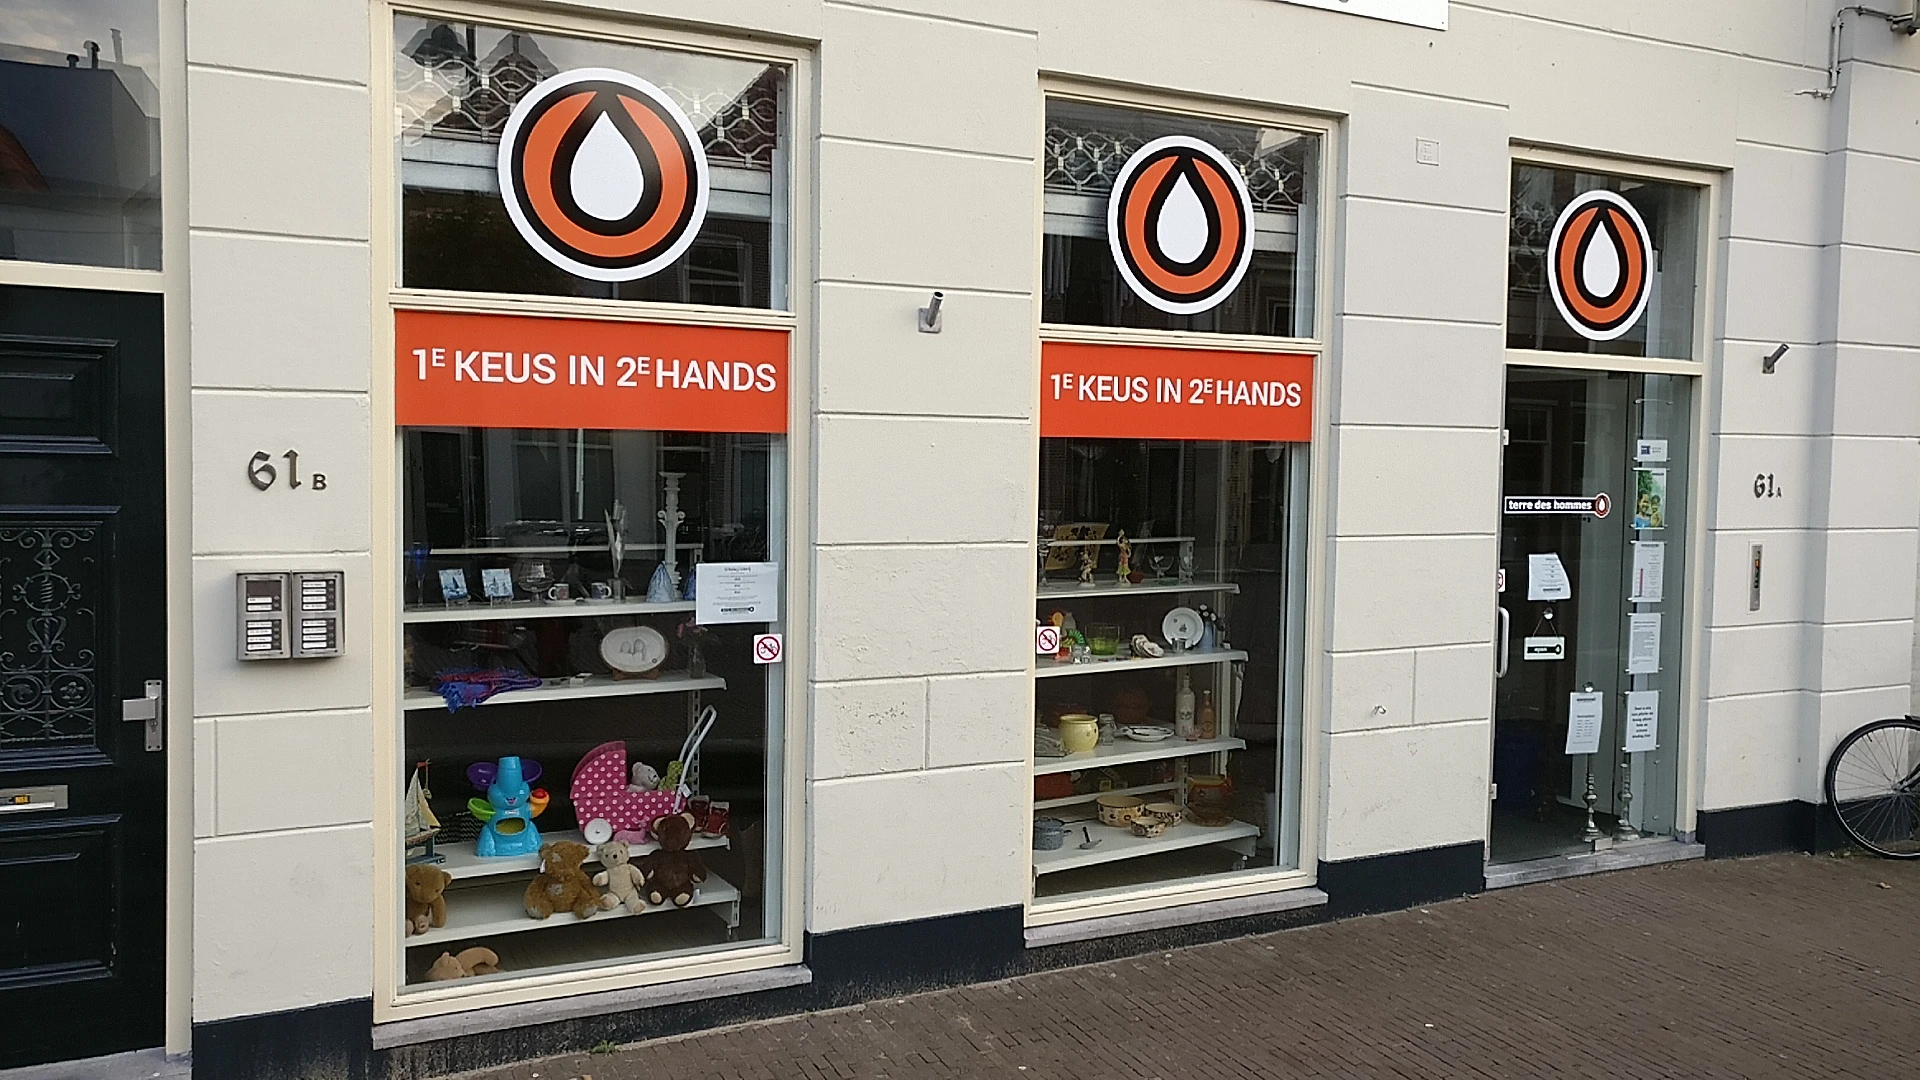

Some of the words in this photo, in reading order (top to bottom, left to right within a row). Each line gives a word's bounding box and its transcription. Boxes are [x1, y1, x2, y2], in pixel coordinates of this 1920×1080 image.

[412, 348, 446, 380] 1E
[455, 350, 557, 385] KEUS
[569, 355, 604, 386] IN
[656, 358, 777, 392] HANDS
[1051, 373, 1074, 400] 1E
[1078, 375, 1149, 403] KEUS
[1156, 377, 1182, 404] IN
[1216, 379, 1302, 407] HANDS
[1508, 499, 1534, 510] terre
[1534, 498, 1552, 510] des
[1553, 498, 1593, 510] hommes
